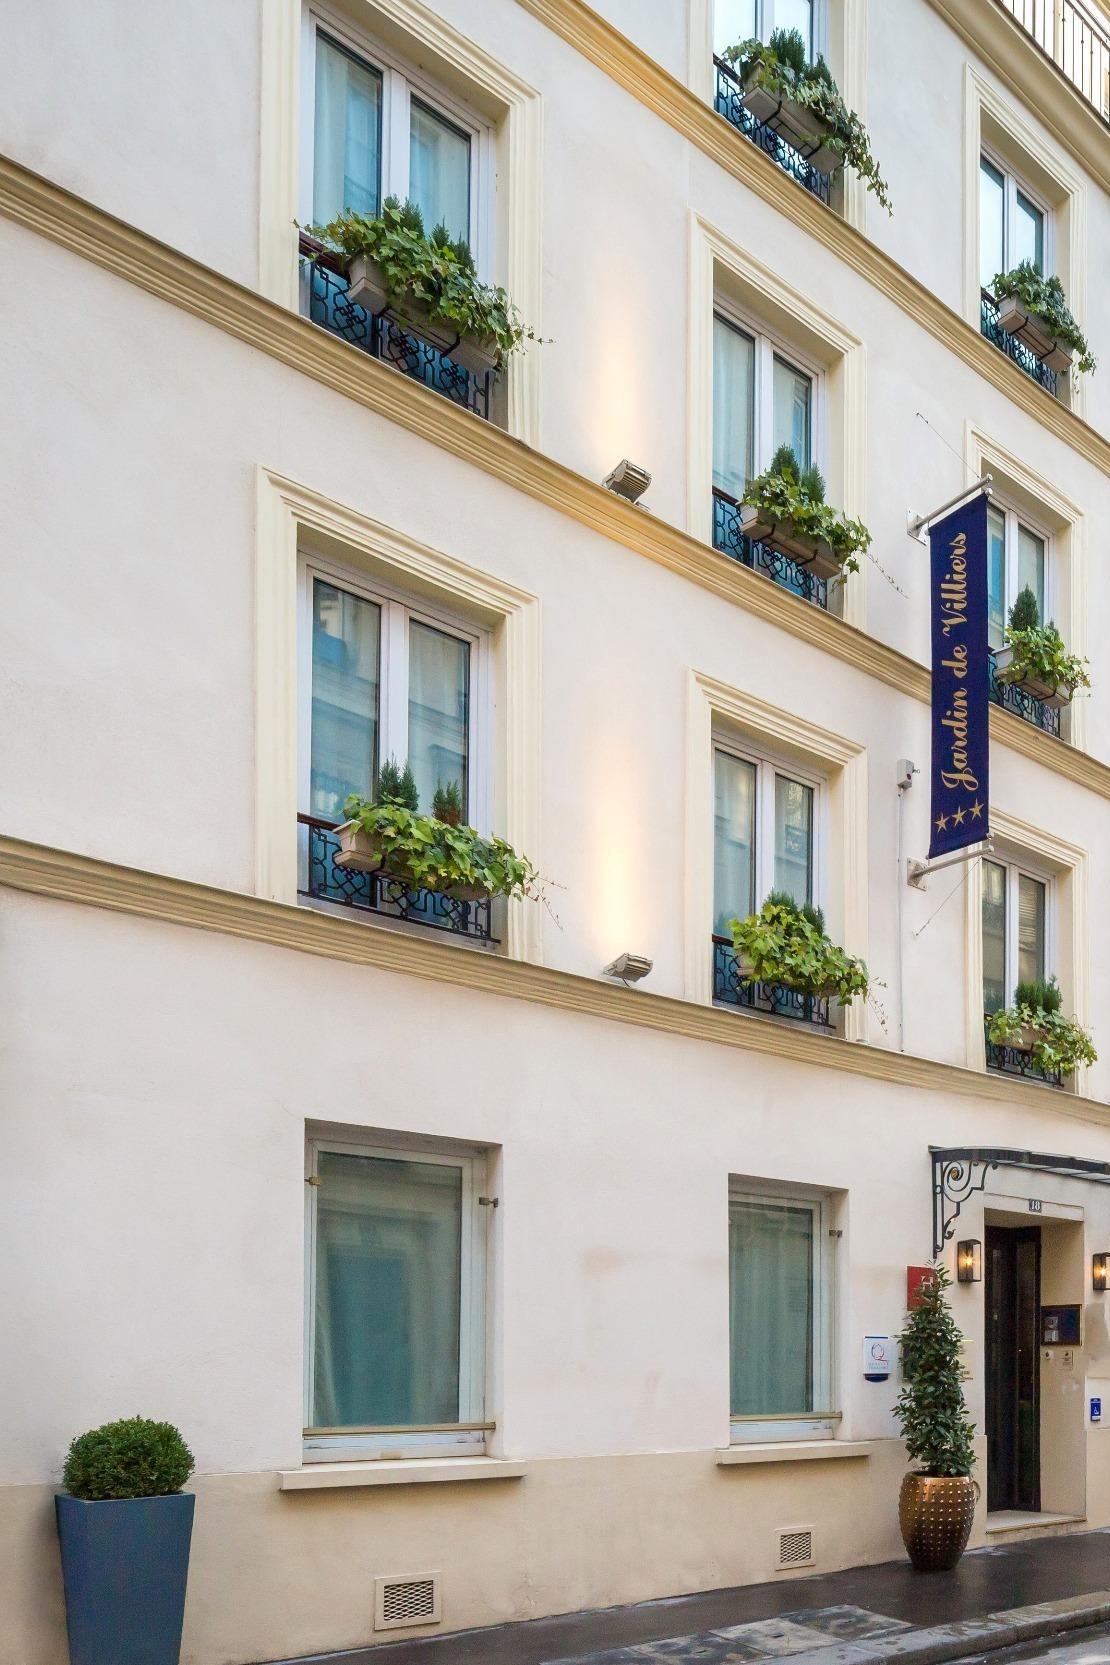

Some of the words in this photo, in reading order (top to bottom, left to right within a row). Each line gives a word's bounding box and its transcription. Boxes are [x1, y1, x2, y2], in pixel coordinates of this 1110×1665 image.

[942, 532, 967, 638] Villiers
[942, 644, 967, 679] de
[941, 687, 979, 791] Jardin
[1031, 1200, 1040, 1211] 18
